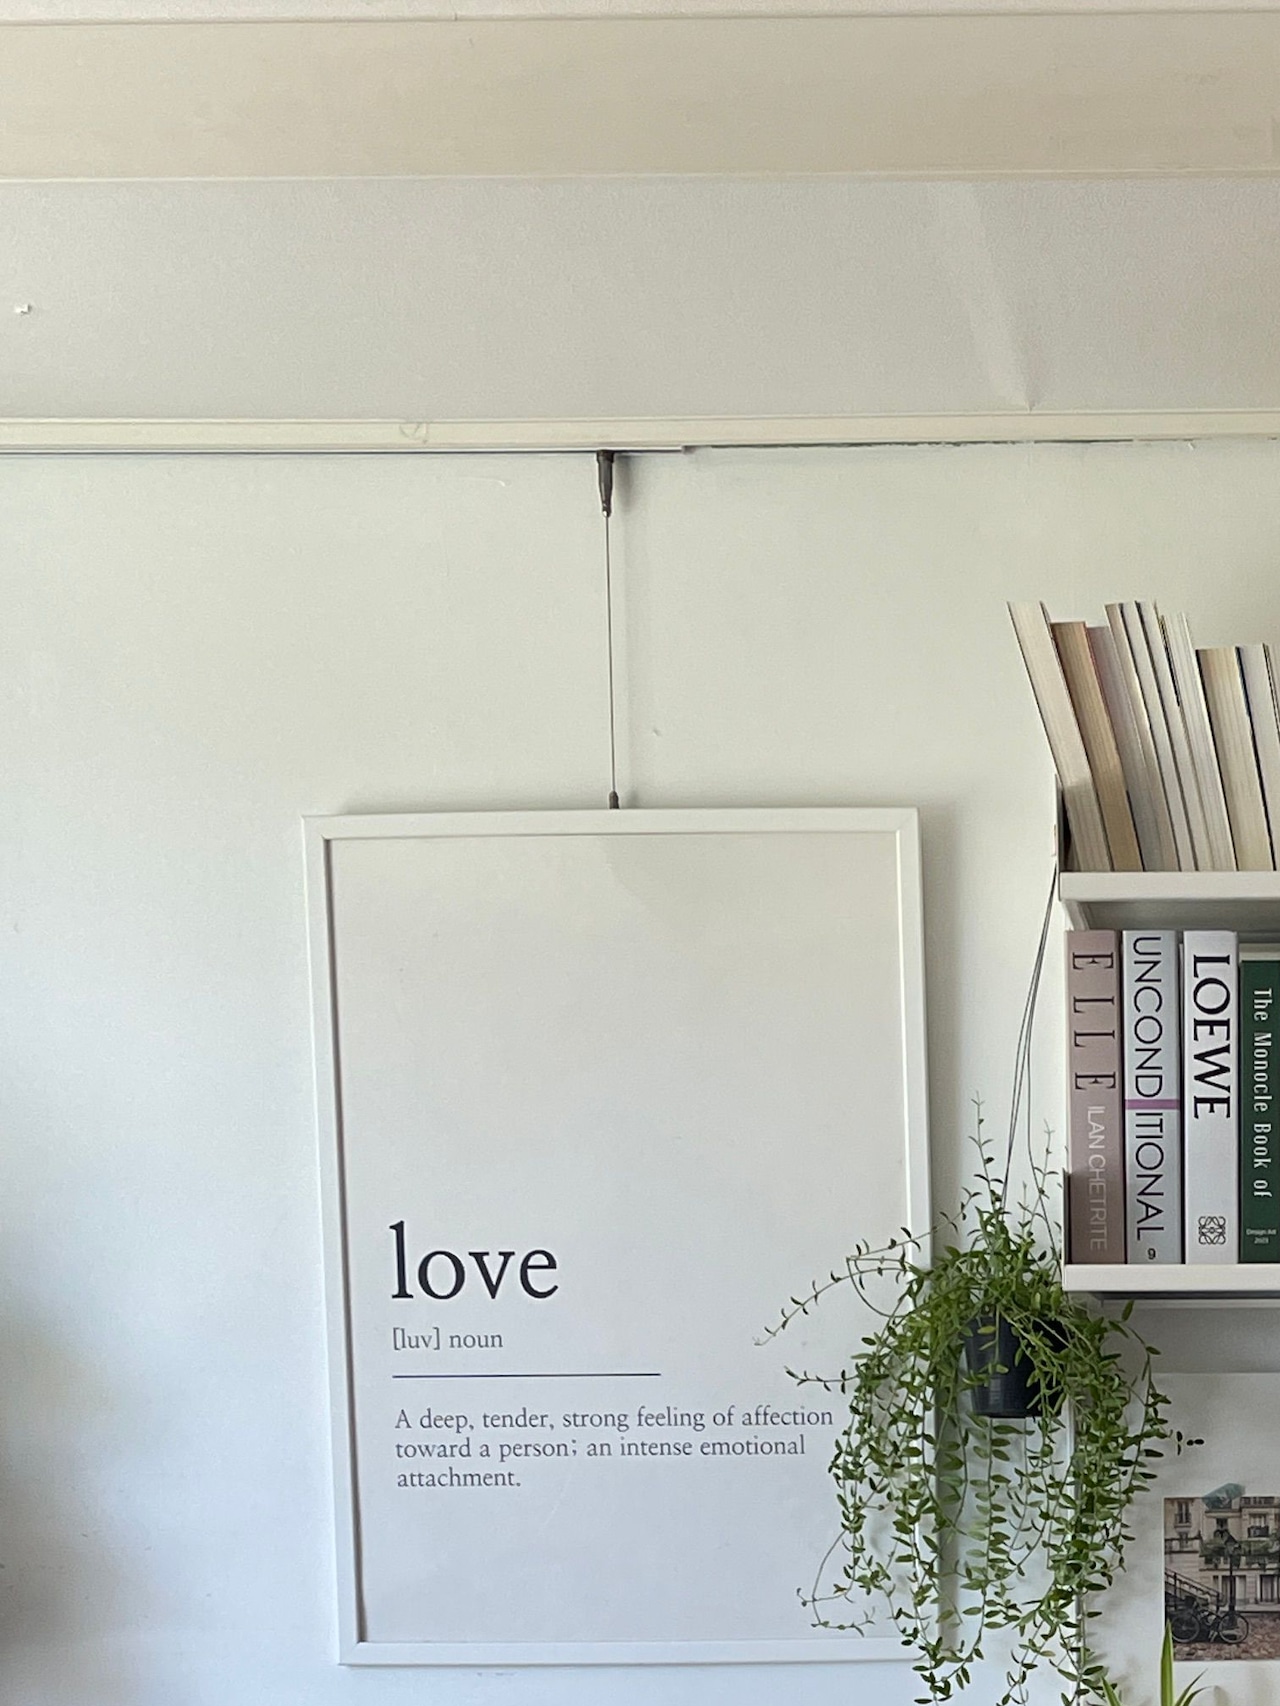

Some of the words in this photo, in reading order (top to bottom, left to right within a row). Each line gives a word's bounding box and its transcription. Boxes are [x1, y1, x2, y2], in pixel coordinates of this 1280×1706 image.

[1072, 952, 1117, 1091] ELLE
[1253, 987, 1272, 1021] The
[1193, 954, 1231, 1119] LOEWE
[1253, 1031, 1273, 1112] Monocle
[1087, 1105, 1106, 1149] ILAN
[1253, 1123, 1272, 1169] Book
[1088, 1154, 1107, 1252] CHETRITE
[1253, 1179, 1273, 1198] of
[388, 1219, 559, 1300] love
[393, 1326, 441, 1351] [luv]
[448, 1333, 504, 1349] noun
[394, 1408, 412, 1429] A
[419, 1407, 475, 1433] deep,
[482, 1406, 555, 1431] tender,
[562, 1411, 630, 1433] strong
[636, 1405, 706, 1433] feeling
[712, 1404, 736, 1426] of
[741, 1404, 834, 1427] affection
[394, 1436, 472, 1459] toward
[479, 1443, 491, 1458] a
[499, 1438, 578, 1463] person;
[586, 1442, 613, 1457] an
[620, 1436, 694, 1457] intense
[699, 1433, 807, 1456] emotional
[396, 1465, 522, 1488] attachment.
